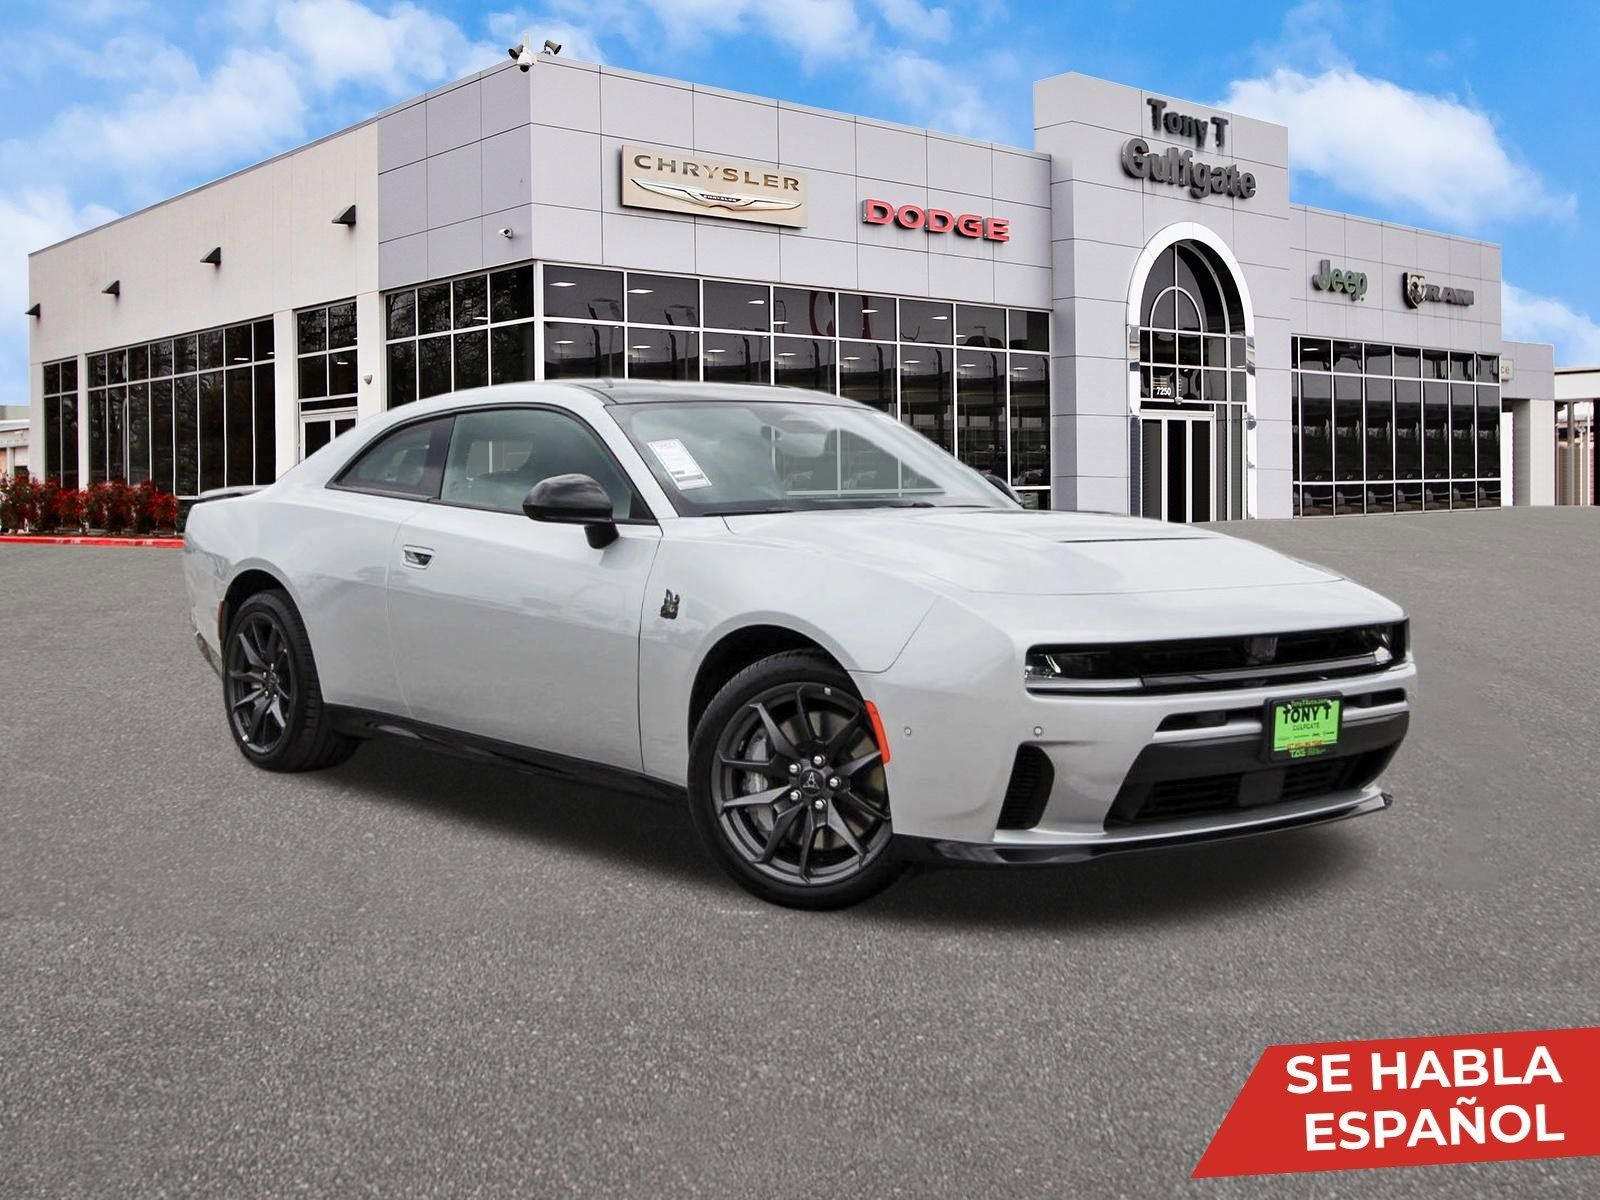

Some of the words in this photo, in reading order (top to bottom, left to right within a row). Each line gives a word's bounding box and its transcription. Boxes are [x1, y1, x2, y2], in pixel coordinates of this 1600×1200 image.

[1147, 98, 1208, 147] Tony
[1210, 116, 1229, 147] T
[633, 154, 800, 192] CHRYSLER
[1121, 138, 1257, 199] Gulfgate
[862, 198, 1010, 242] DODGE
[1312, 259, 1368, 302] Jeep
[1424, 283, 1475, 307] RAM
[1156, 386, 1172, 396] 7250
[1283, 704, 1320, 725] TONY
[1323, 703, 1332, 720] T
